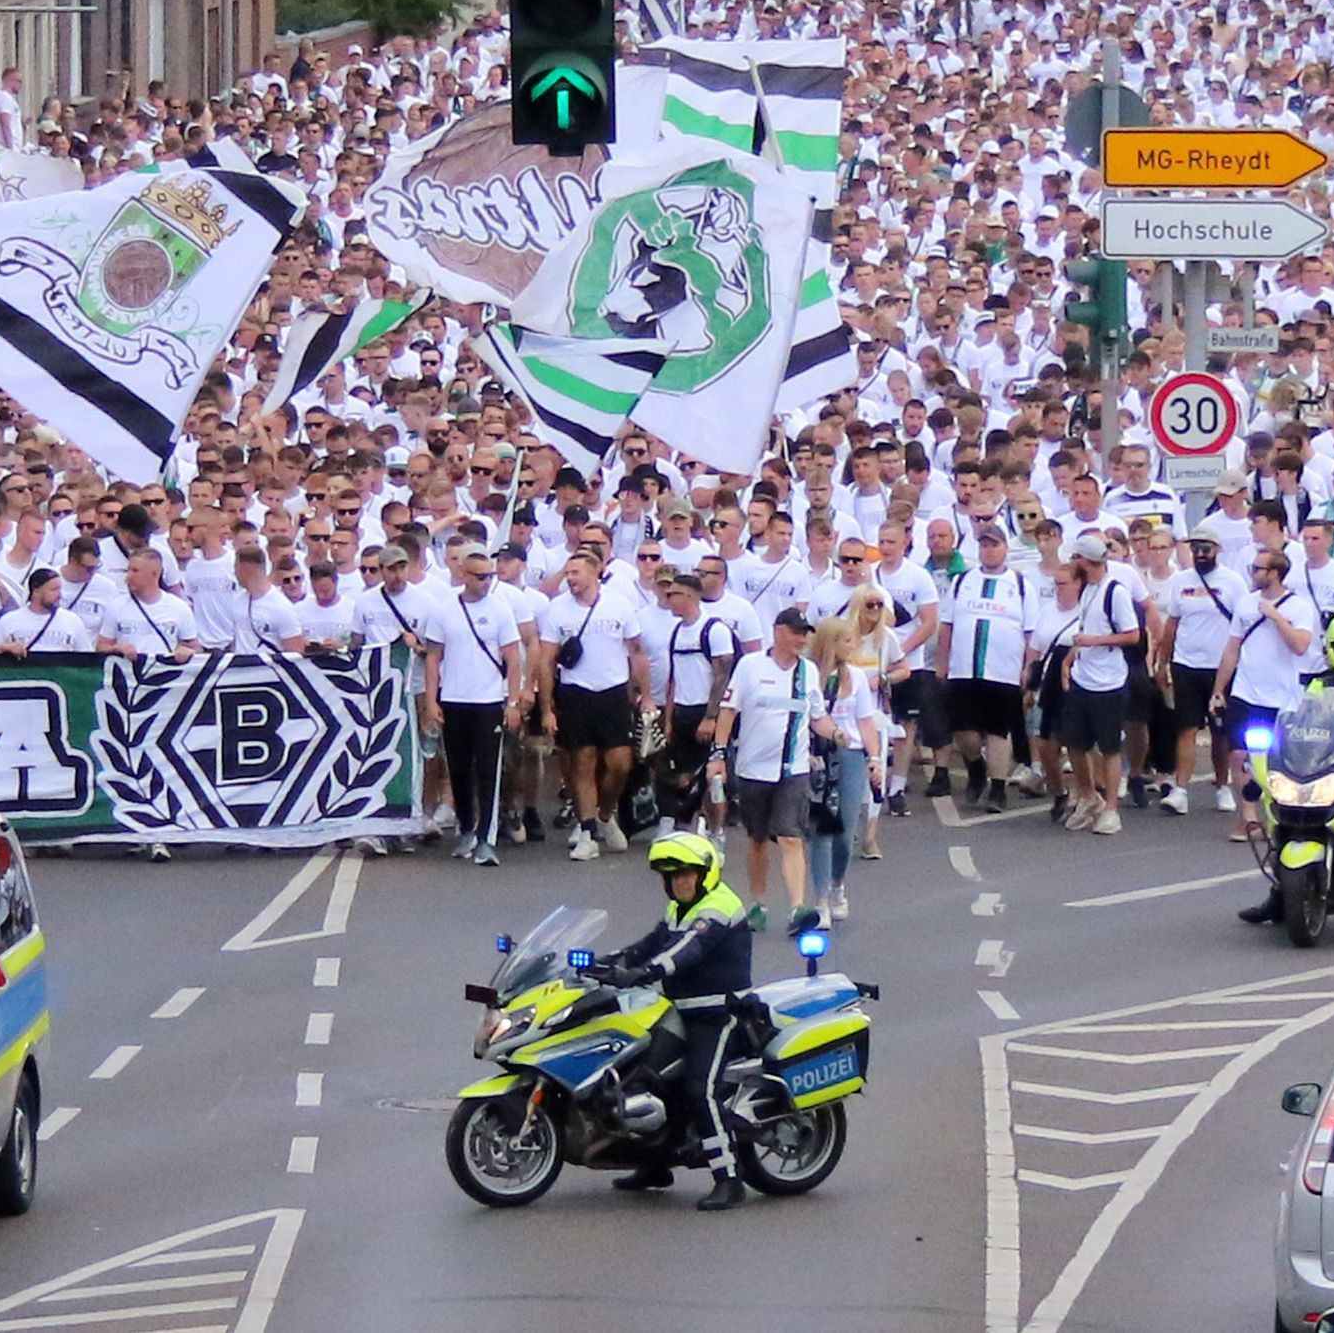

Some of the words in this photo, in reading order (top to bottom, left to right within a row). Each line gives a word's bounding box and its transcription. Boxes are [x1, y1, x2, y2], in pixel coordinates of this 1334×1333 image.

[1136, 149, 1272, 175] MG-Rheydt
[1134, 218, 1273, 241] Hochschule
[1211, 331, 1275, 348] Bahnstraße
[1169, 396, 1219, 435] 30
[791, 1055, 855, 1093] POLIZEI
